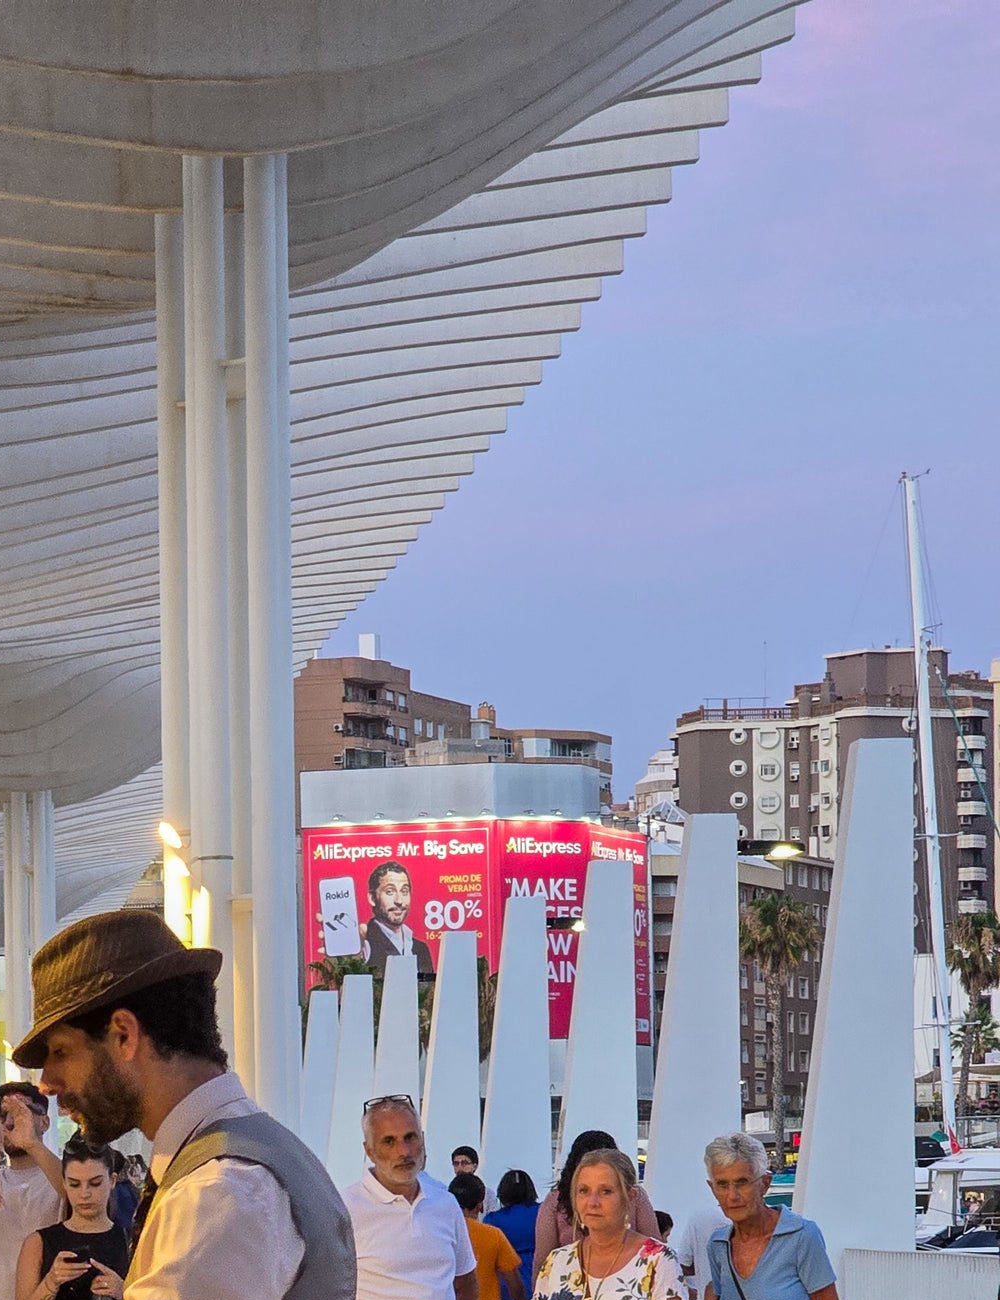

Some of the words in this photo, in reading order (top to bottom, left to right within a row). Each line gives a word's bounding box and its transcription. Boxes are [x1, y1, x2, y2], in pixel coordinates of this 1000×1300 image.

[314, 842, 392, 862] AliExpress
[396, 842, 420, 857] Mr.
[423, 840, 448, 860] Big
[449, 839, 485, 856] Save
[506, 837, 582, 857] AliExpress
[439, 874, 469, 884] PROMO
[470, 874, 482, 882] DE
[325, 890, 350, 901] Rokid
[447, 883, 482, 893] VERANO
[424, 899, 483, 930] 80%
